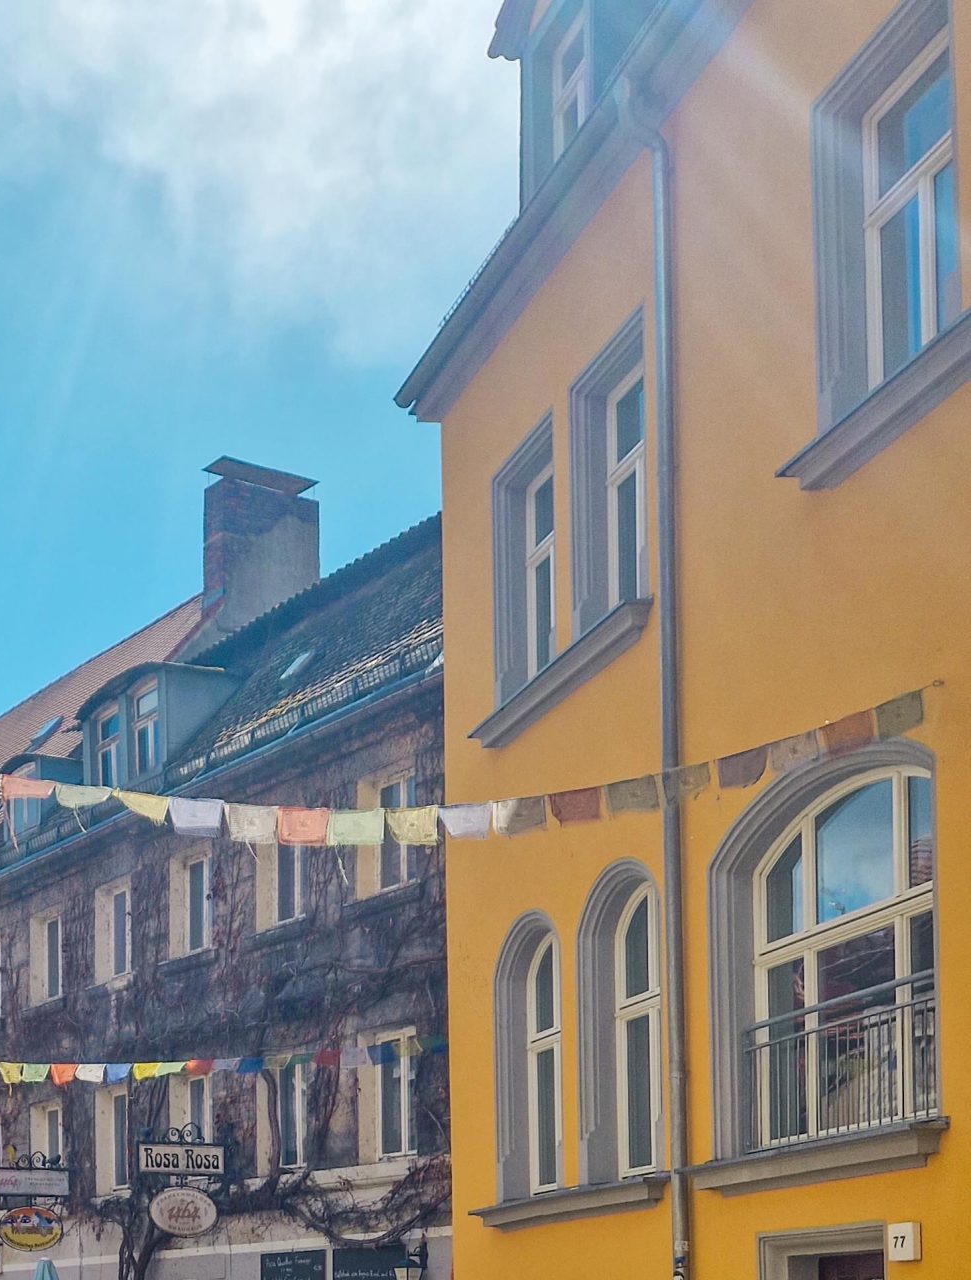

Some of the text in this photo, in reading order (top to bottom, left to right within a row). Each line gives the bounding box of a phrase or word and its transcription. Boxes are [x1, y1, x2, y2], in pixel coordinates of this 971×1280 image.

[143, 1147, 220, 1170] Rosa Rosa
[892, 1235, 906, 1248] 77
